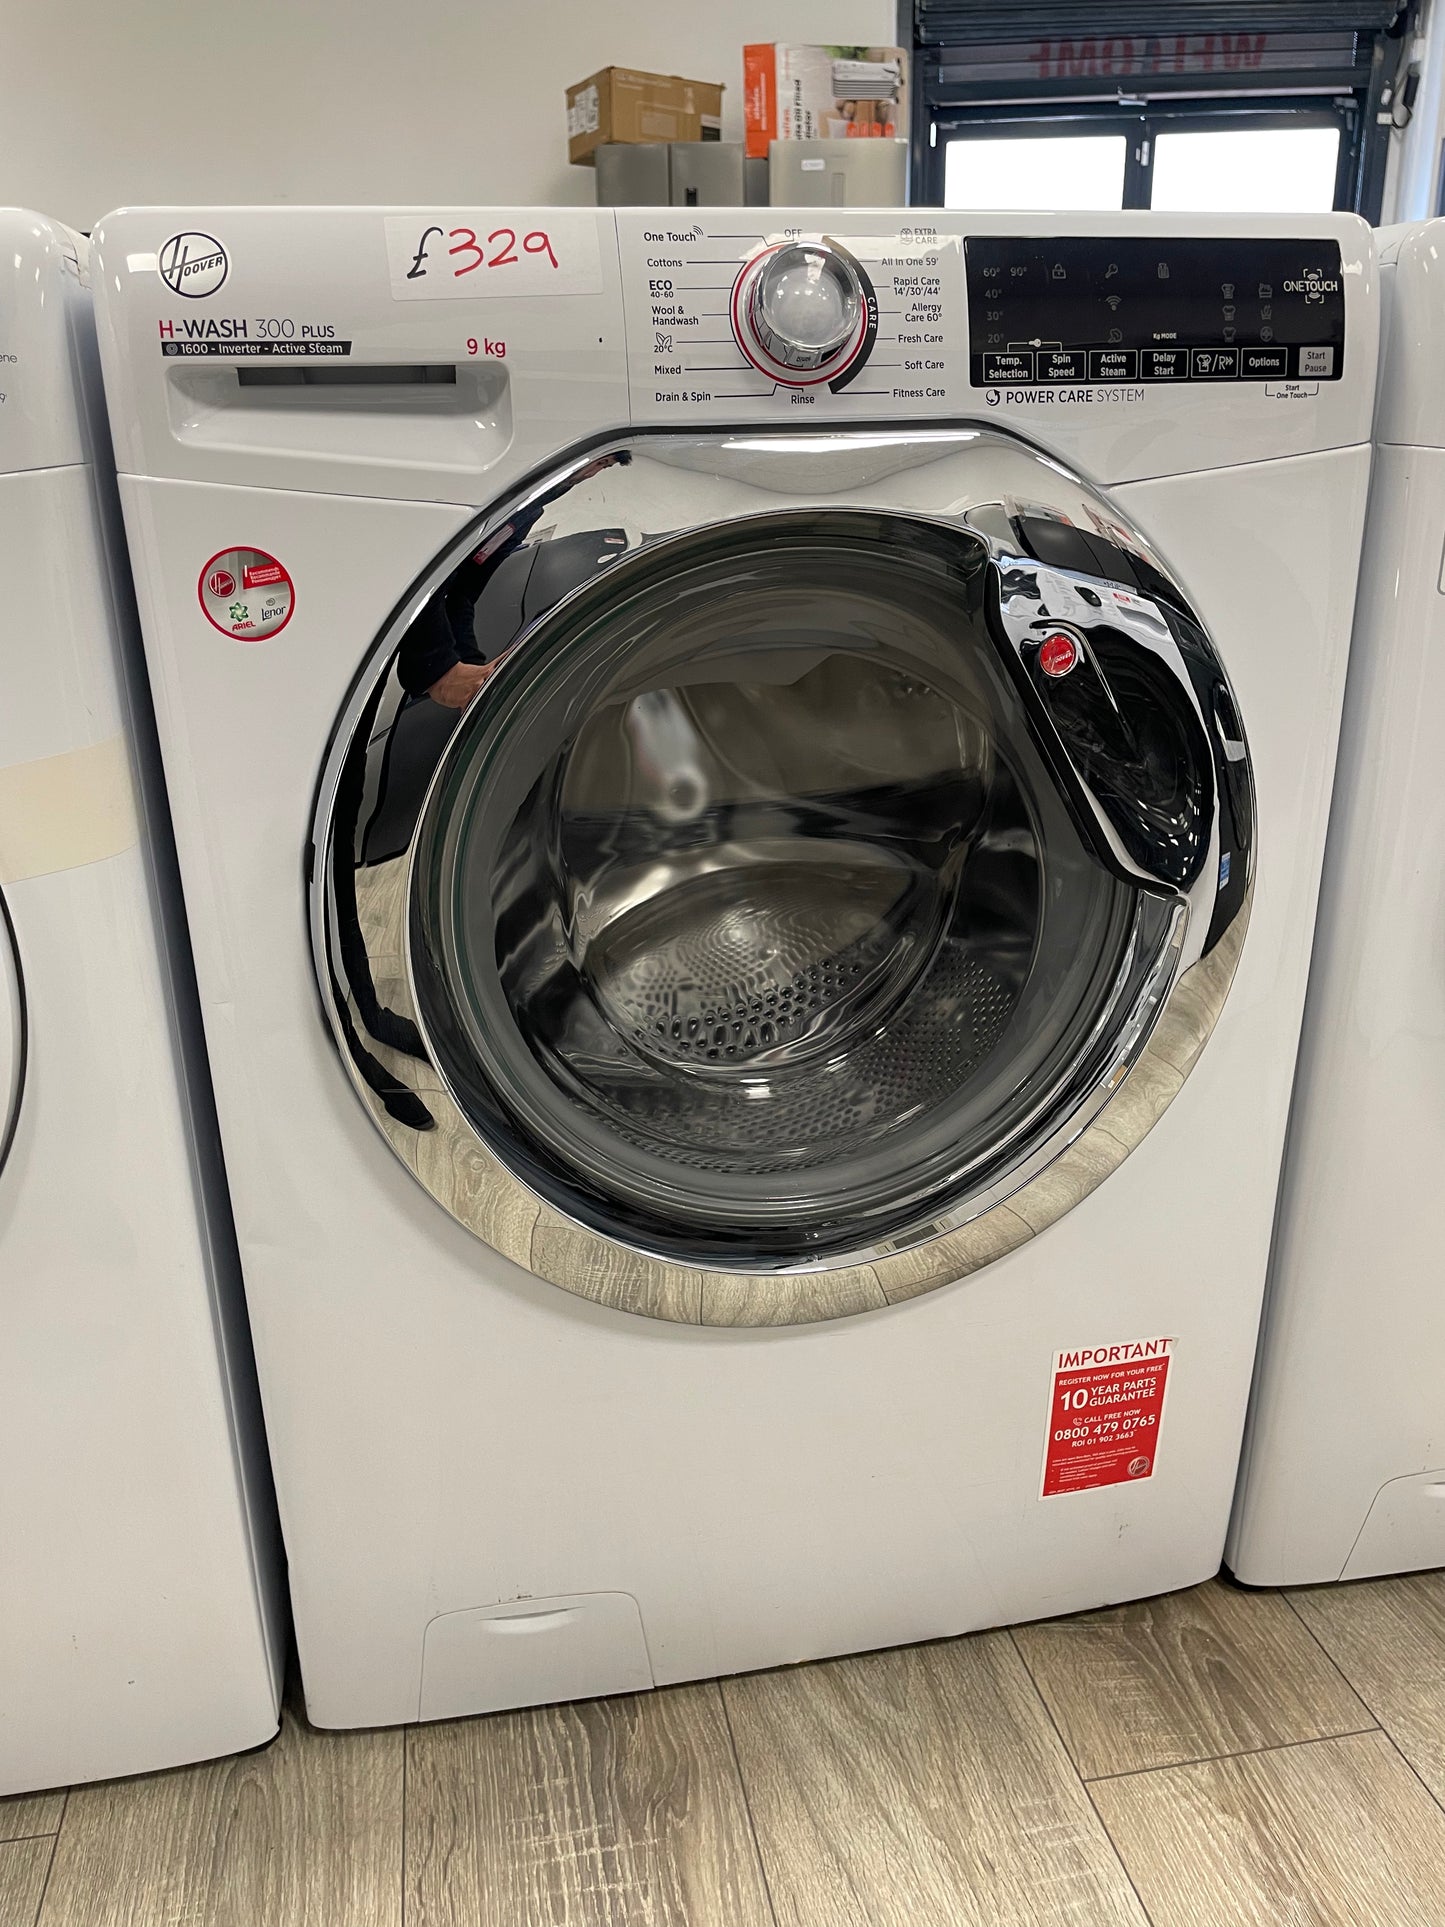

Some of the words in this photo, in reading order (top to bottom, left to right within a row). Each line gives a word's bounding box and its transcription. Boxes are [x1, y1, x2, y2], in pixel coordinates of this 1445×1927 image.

[643, 232, 664, 242] One
[668, 232, 697, 242] Touch
[784, 229, 803, 238] OFF
[914, 228, 937, 236] EXTRA
[915, 237, 938, 245] CARE
[407, 227, 558, 280] £329
[161, 235, 225, 292] HOOVER
[647, 258, 683, 267] Cottons
[881, 257, 894, 266] All
[895, 257, 903, 266] In
[906, 257, 924, 266] One
[926, 257, 939, 266] 59'
[649, 280, 673, 291] ECO
[893, 277, 919, 287] Rapid
[921, 277, 940, 286] Care
[652, 306, 676, 315] Wool
[677, 306, 685, 315] &
[867, 296, 877, 329] CARE
[911, 303, 942, 314] Allergy
[652, 316, 699, 325] Handwash
[905, 314, 925, 322] Care
[927, 313, 943, 322] 60°
[158, 319, 248, 339] H-WASH
[255, 319, 295, 339] 300
[302, 325, 335, 338] PLUS
[898, 334, 922, 343] Fresh
[924, 334, 944, 343] Care
[181, 343, 208, 355] 1600
[218, 343, 261, 354] Inverter
[272, 343, 308, 354] Active
[466, 338, 478, 355] 9
[484, 338, 506, 358] kg
[654, 344, 674, 353] 20°C
[1052, 354, 1071, 364] Spin
[1100, 354, 1127, 363] Active
[1153, 352, 1177, 364] Delay
[1307, 351, 1326, 360] Start
[904, 361, 923, 370] Soft
[924, 360, 945, 369] Care
[995, 356, 1022, 366] Temp.
[1249, 357, 1280, 367] Options
[654, 365, 682, 374] Mixed
[988, 368, 1028, 379] Selection
[1048, 367, 1075, 377] Speed
[1100, 367, 1126, 376] Steam
[1154, 366, 1174, 375] Start
[1304, 364, 1327, 373] Pause
[893, 388, 924, 398] Fitness
[925, 388, 946, 397] Care
[1285, 384, 1300, 392] Start
[655, 392, 680, 402] Drain
[682, 392, 689, 401] &
[691, 391, 711, 403] Spin
[791, 395, 815, 404] Rinse
[1006, 391, 1055, 404] POWER
[1058, 389, 1093, 403] CARE
[1097, 388, 1145, 403] SYSTEM
[1290, 391, 1308, 399] Touch
[261, 606, 286, 621] Lenor
[232, 620, 256, 632] ARIEL
[1058, 1339, 1173, 1369] IMPORTANT
[1059, 1376, 1091, 1386] REGISTER
[1092, 1373, 1110, 1381] NOW
[1111, 1371, 1125, 1379] FOR
[1127, 1368, 1145, 1376] YOUR
[1060, 1388, 1089, 1411] 10
[1091, 1383, 1120, 1396] YEAR
[1123, 1377, 1157, 1391] PARTS
[1089, 1387, 1156, 1407] GUARANTEE
[1084, 1415, 1102, 1424] CALL
[1104, 1412, 1122, 1420] FREE
[1123, 1408, 1141, 1417] NOW
[1054, 1426, 1089, 1441] 0800
[1093, 1421, 1118, 1435] 479
[1122, 1414, 1156, 1430] 0765
[1071, 1440, 1085, 1448] ROI
[1099, 1435, 1113, 1443] 902
